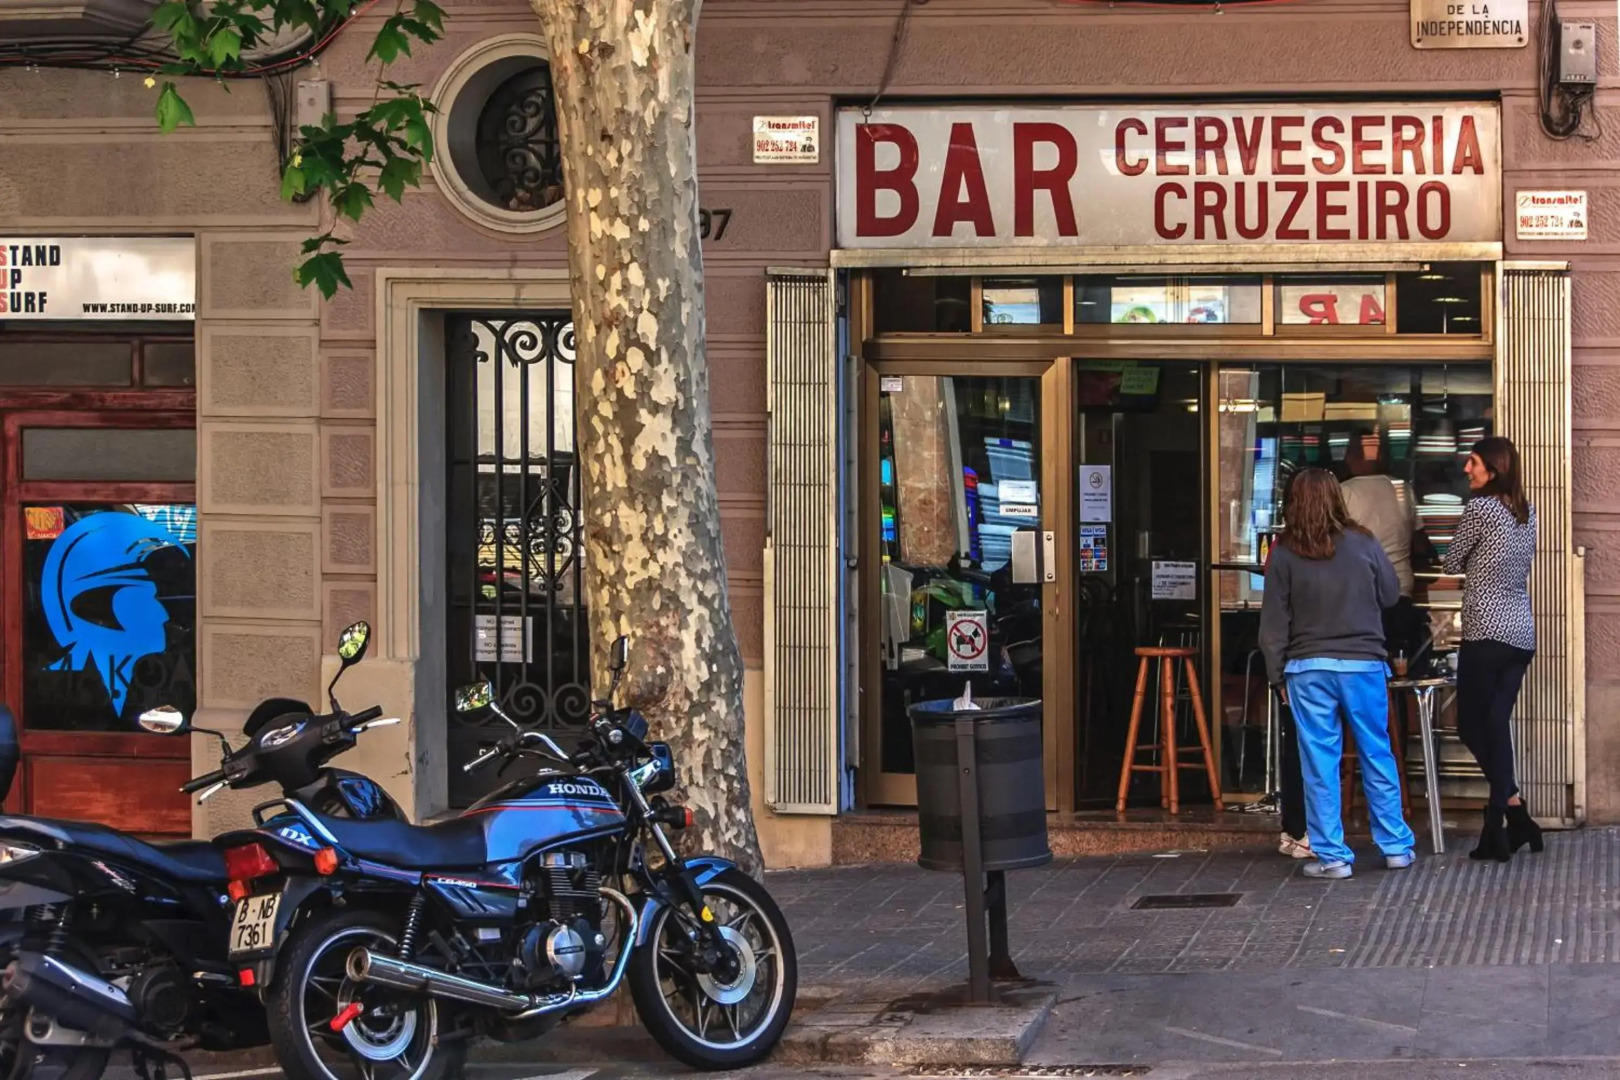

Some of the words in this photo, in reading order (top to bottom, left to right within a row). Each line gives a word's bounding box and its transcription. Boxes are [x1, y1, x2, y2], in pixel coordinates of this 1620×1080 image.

[1447, 4, 1464, 15] DE
[1472, 4, 1489, 15] LA
[1115, 115, 1484, 177] CERVESERIA
[855, 122, 1078, 238] BAR
[1154, 181, 1452, 241] CRUZEIRO
[0, 245, 61, 266] STAND
[0, 292, 47, 313] SURF
[281, 827, 312, 846] DX
[237, 921, 266, 948] 7361
